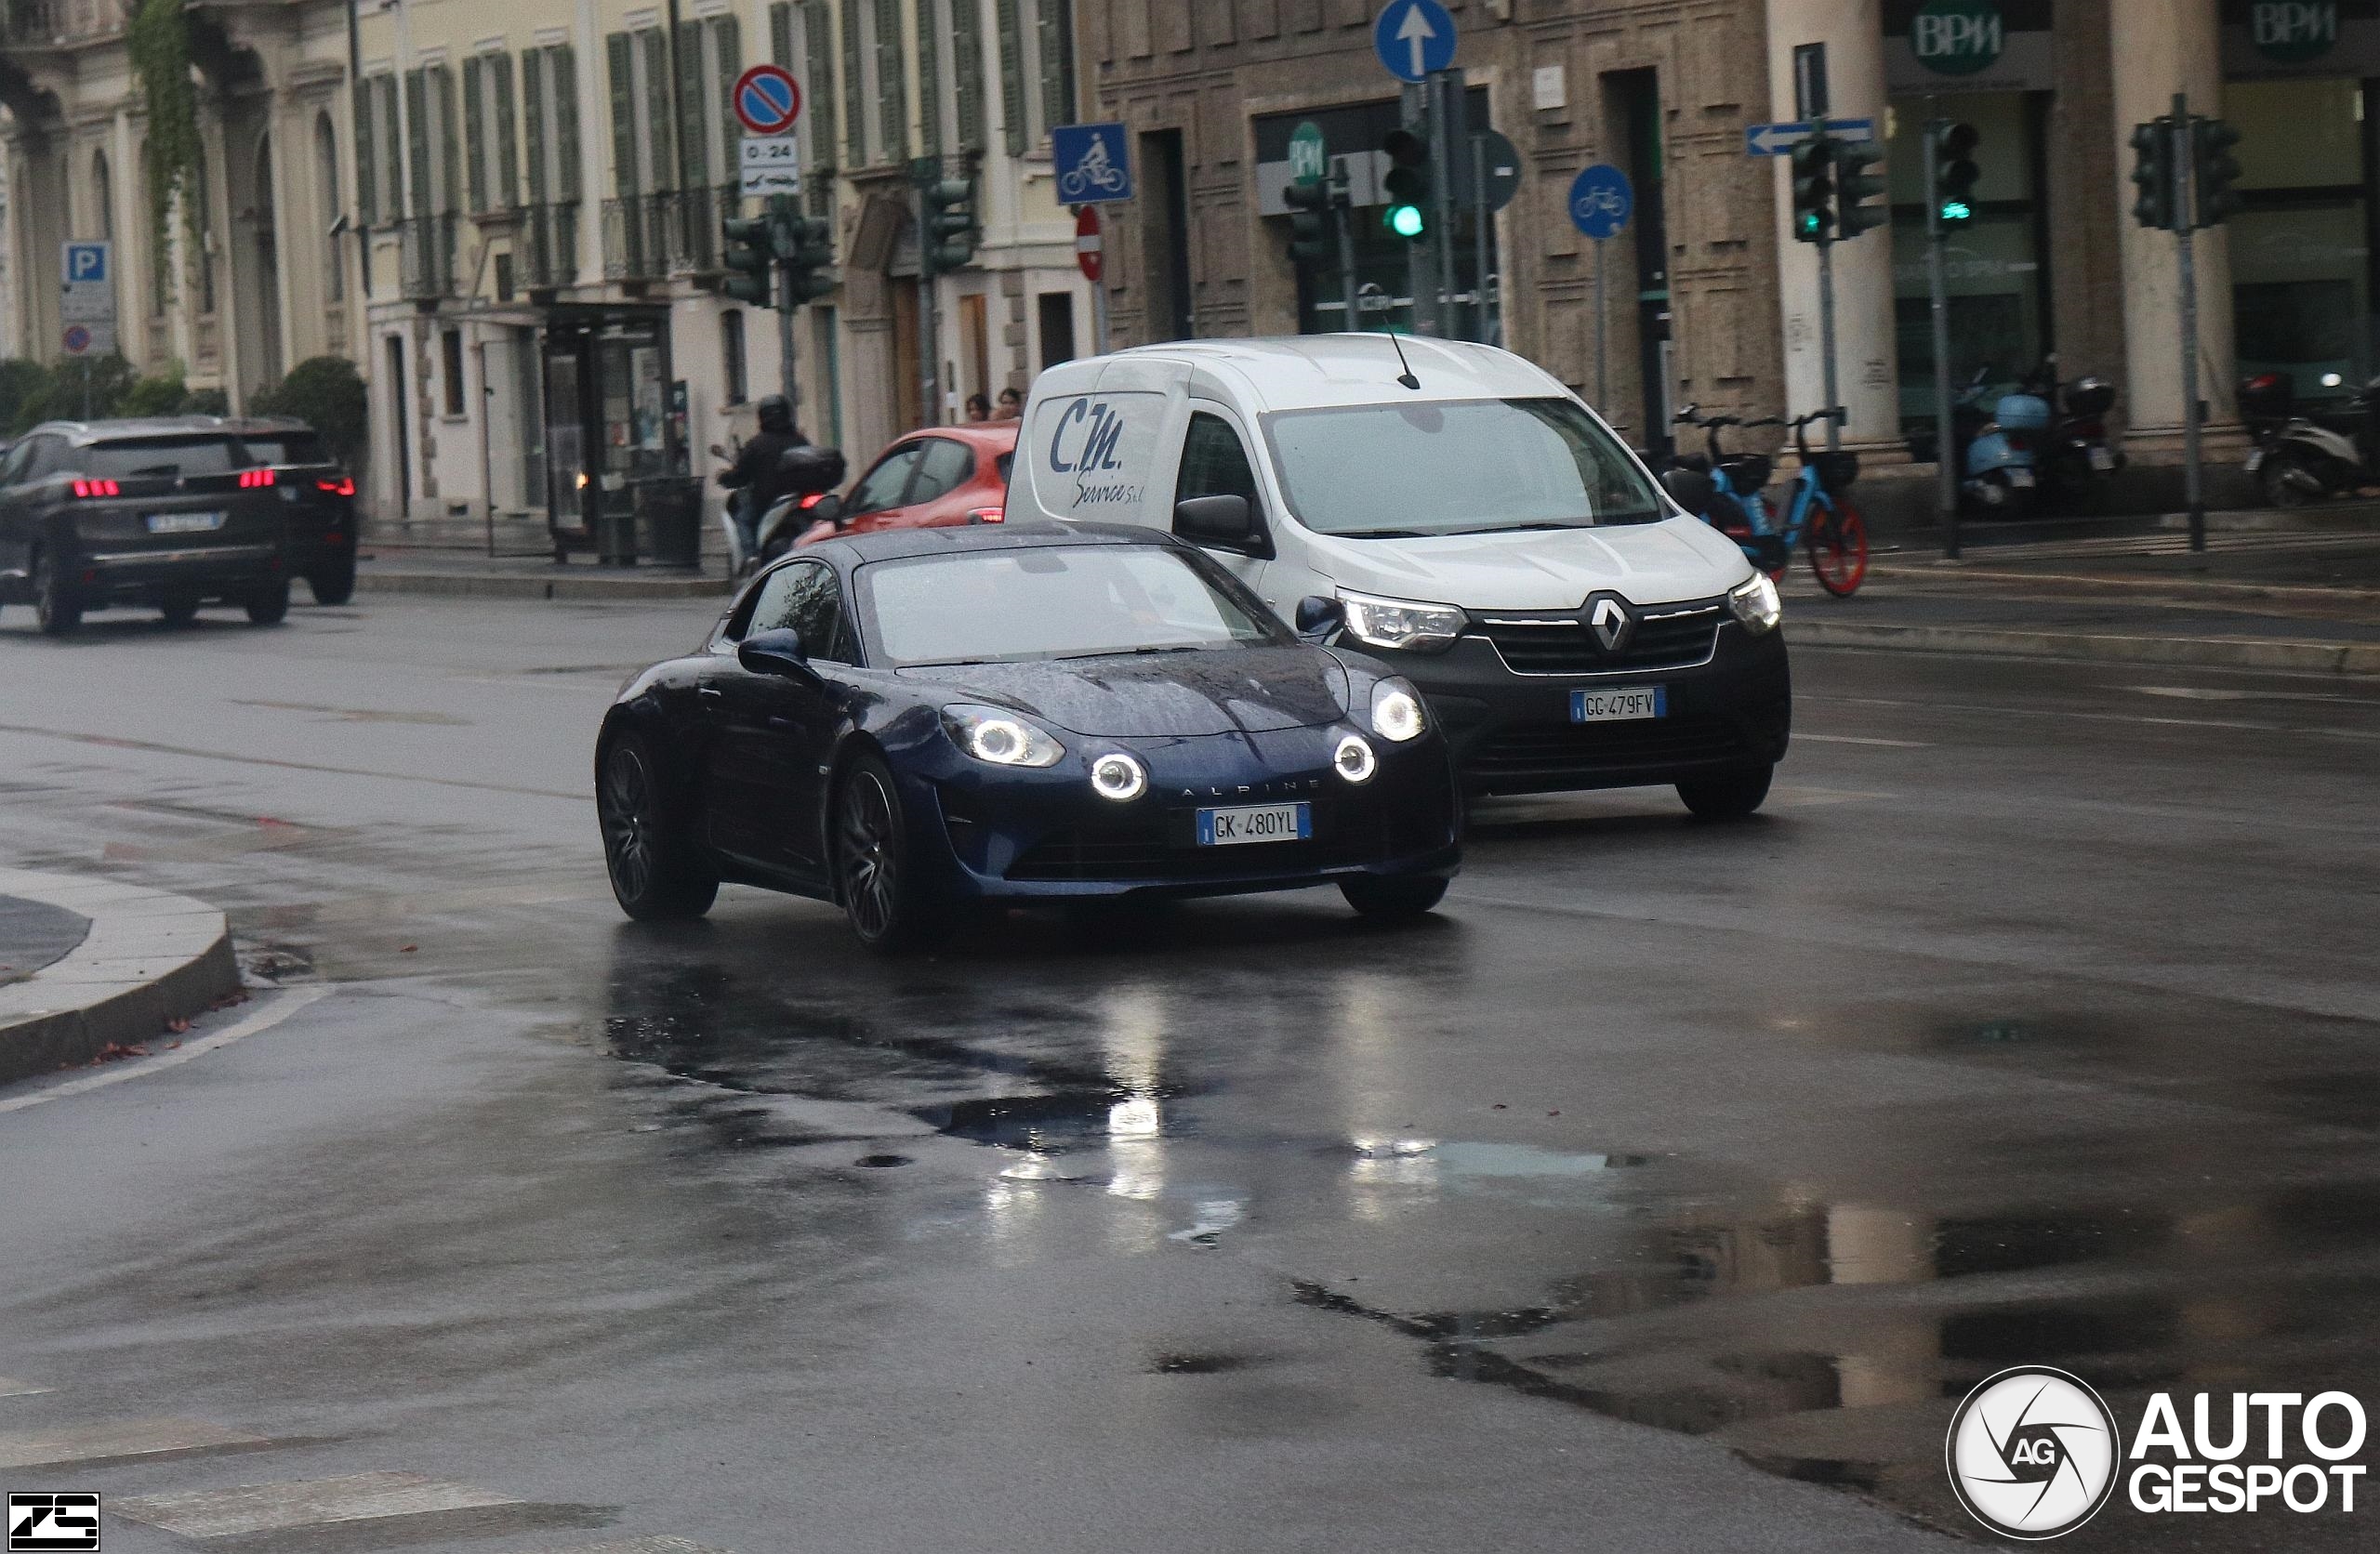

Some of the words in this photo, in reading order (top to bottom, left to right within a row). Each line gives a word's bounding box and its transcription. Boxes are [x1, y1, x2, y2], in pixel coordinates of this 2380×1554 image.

[1916, 14, 2000, 56] BPM
[75, 250, 97, 278] P
[1072, 467, 1125, 508] Service
[1182, 779, 1320, 797] ALPINE
